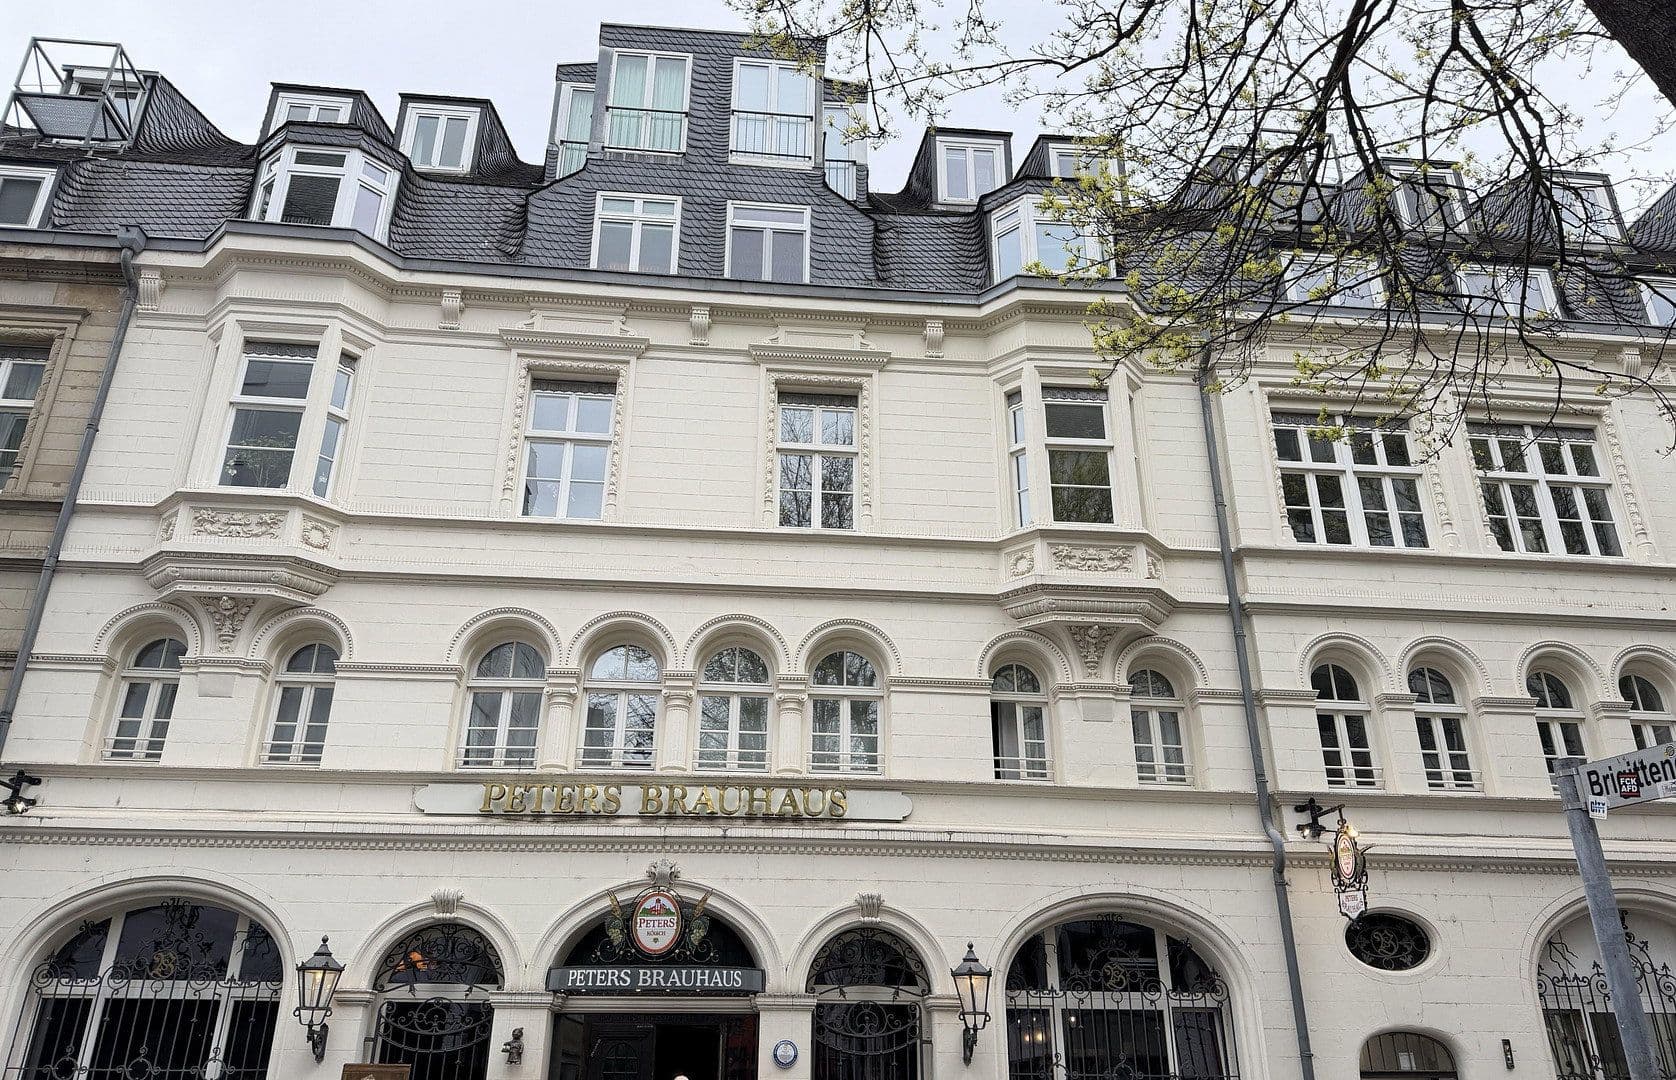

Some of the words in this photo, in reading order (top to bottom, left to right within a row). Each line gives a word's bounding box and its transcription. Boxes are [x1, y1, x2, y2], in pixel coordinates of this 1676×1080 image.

[1586, 758, 1676, 799] Britten
[1620, 777, 1637, 785] FCK
[1621, 785, 1638, 793] AFD
[479, 783, 622, 814] PETERS
[638, 784, 848, 817] BRAUHAUS
[638, 917, 675, 929] PETERS
[567, 969, 631, 987] PETERS
[637, 969, 742, 988] BRAUHAUS
